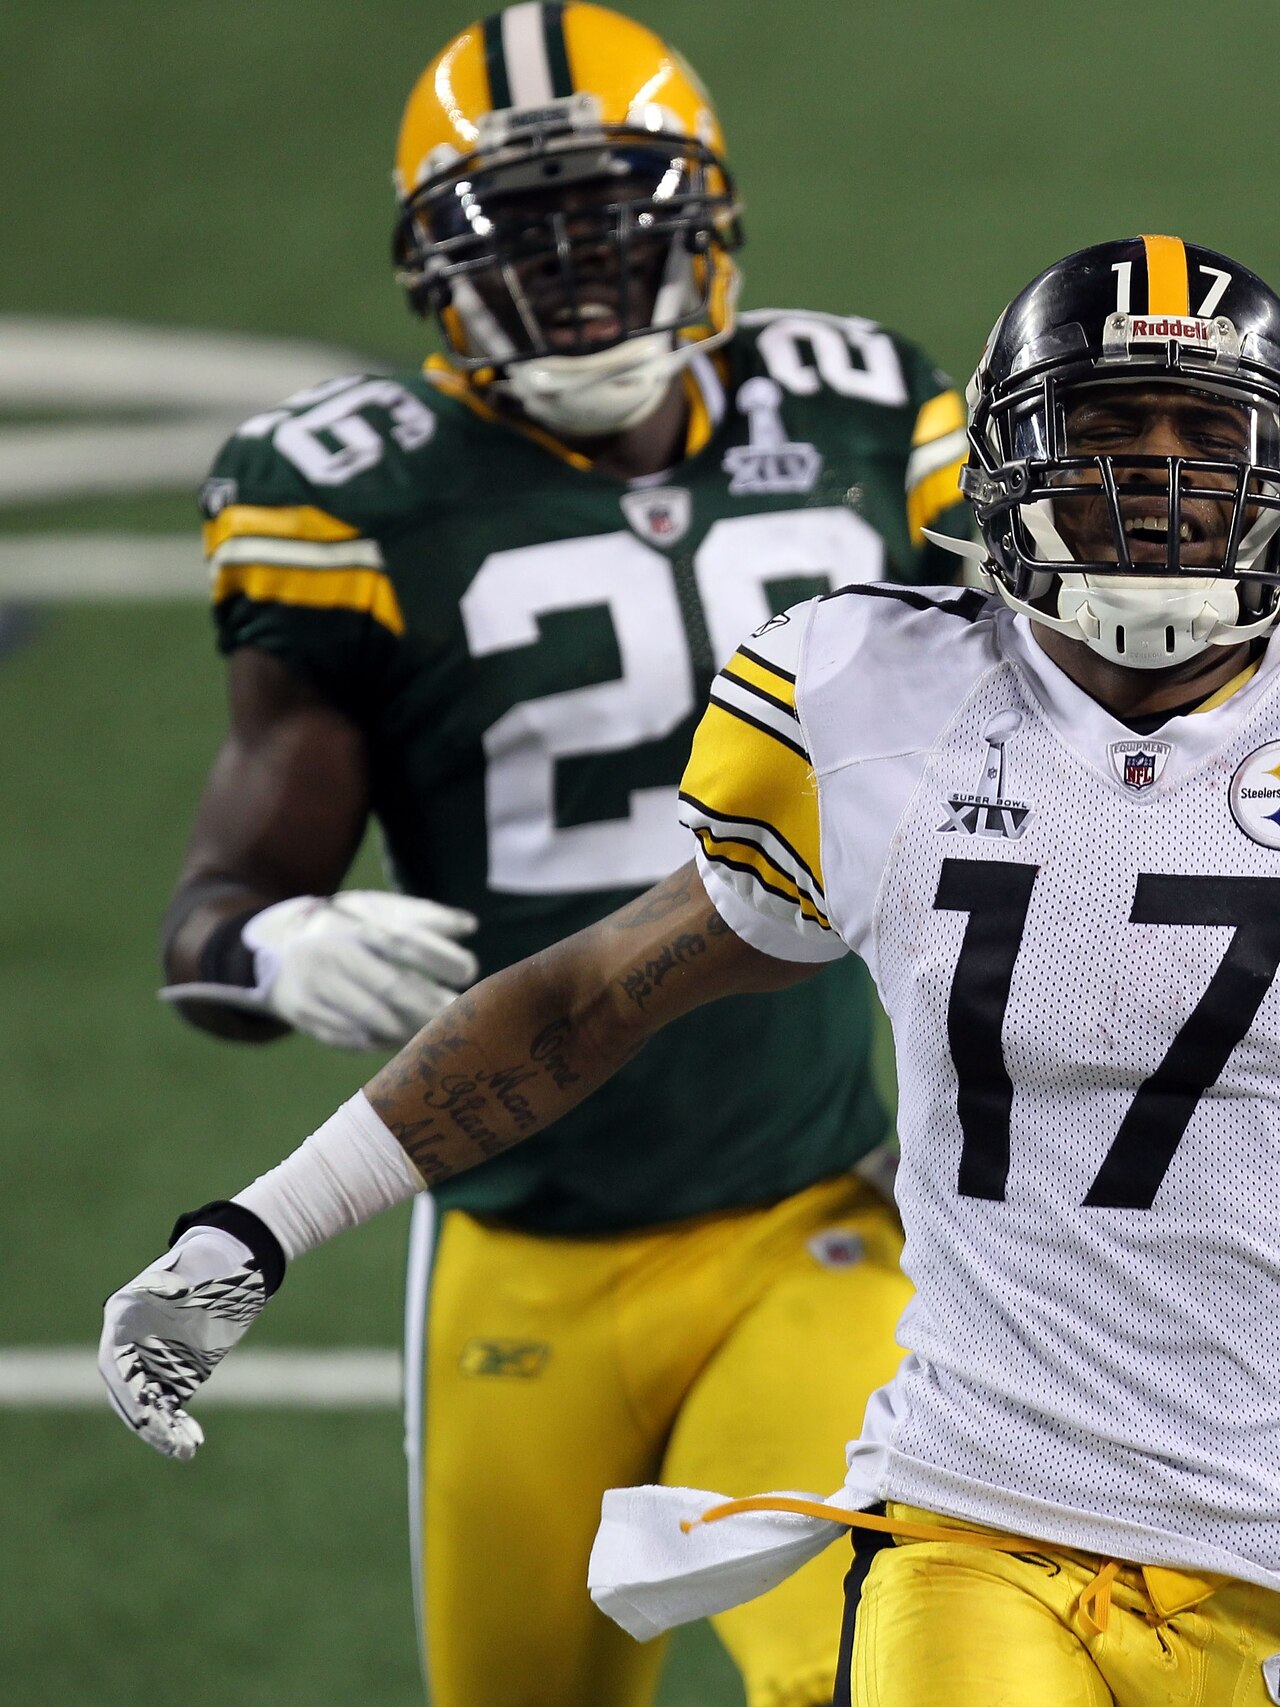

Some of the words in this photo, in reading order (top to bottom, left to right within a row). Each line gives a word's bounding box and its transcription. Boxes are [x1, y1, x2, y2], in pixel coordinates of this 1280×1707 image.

[1114, 742, 1169, 755] EQUIPMENT
[1127, 767, 1153, 785] NFL
[952, 793, 990, 805] SUPER
[996, 798, 1027, 809] BOWL
[936, 801, 1037, 840] XLV
